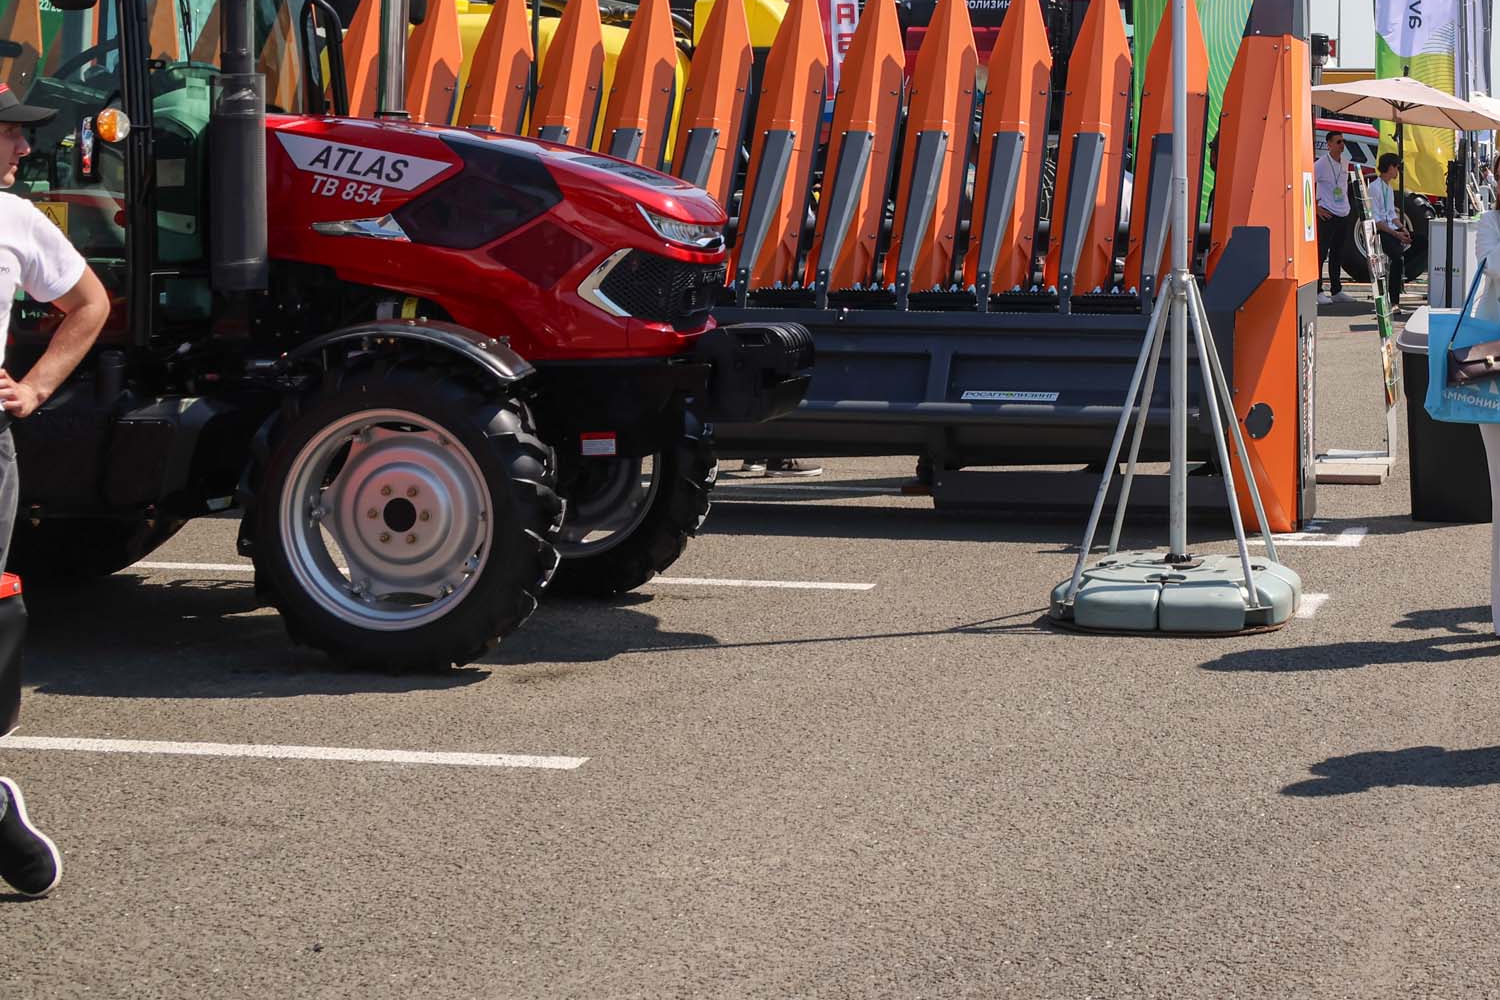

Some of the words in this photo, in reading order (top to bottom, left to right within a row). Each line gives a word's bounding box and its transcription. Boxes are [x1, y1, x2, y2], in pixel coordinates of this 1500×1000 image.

[308, 145, 409, 183] ATLAS
[311, 175, 340, 197] TB
[341, 181, 384, 205] 854
